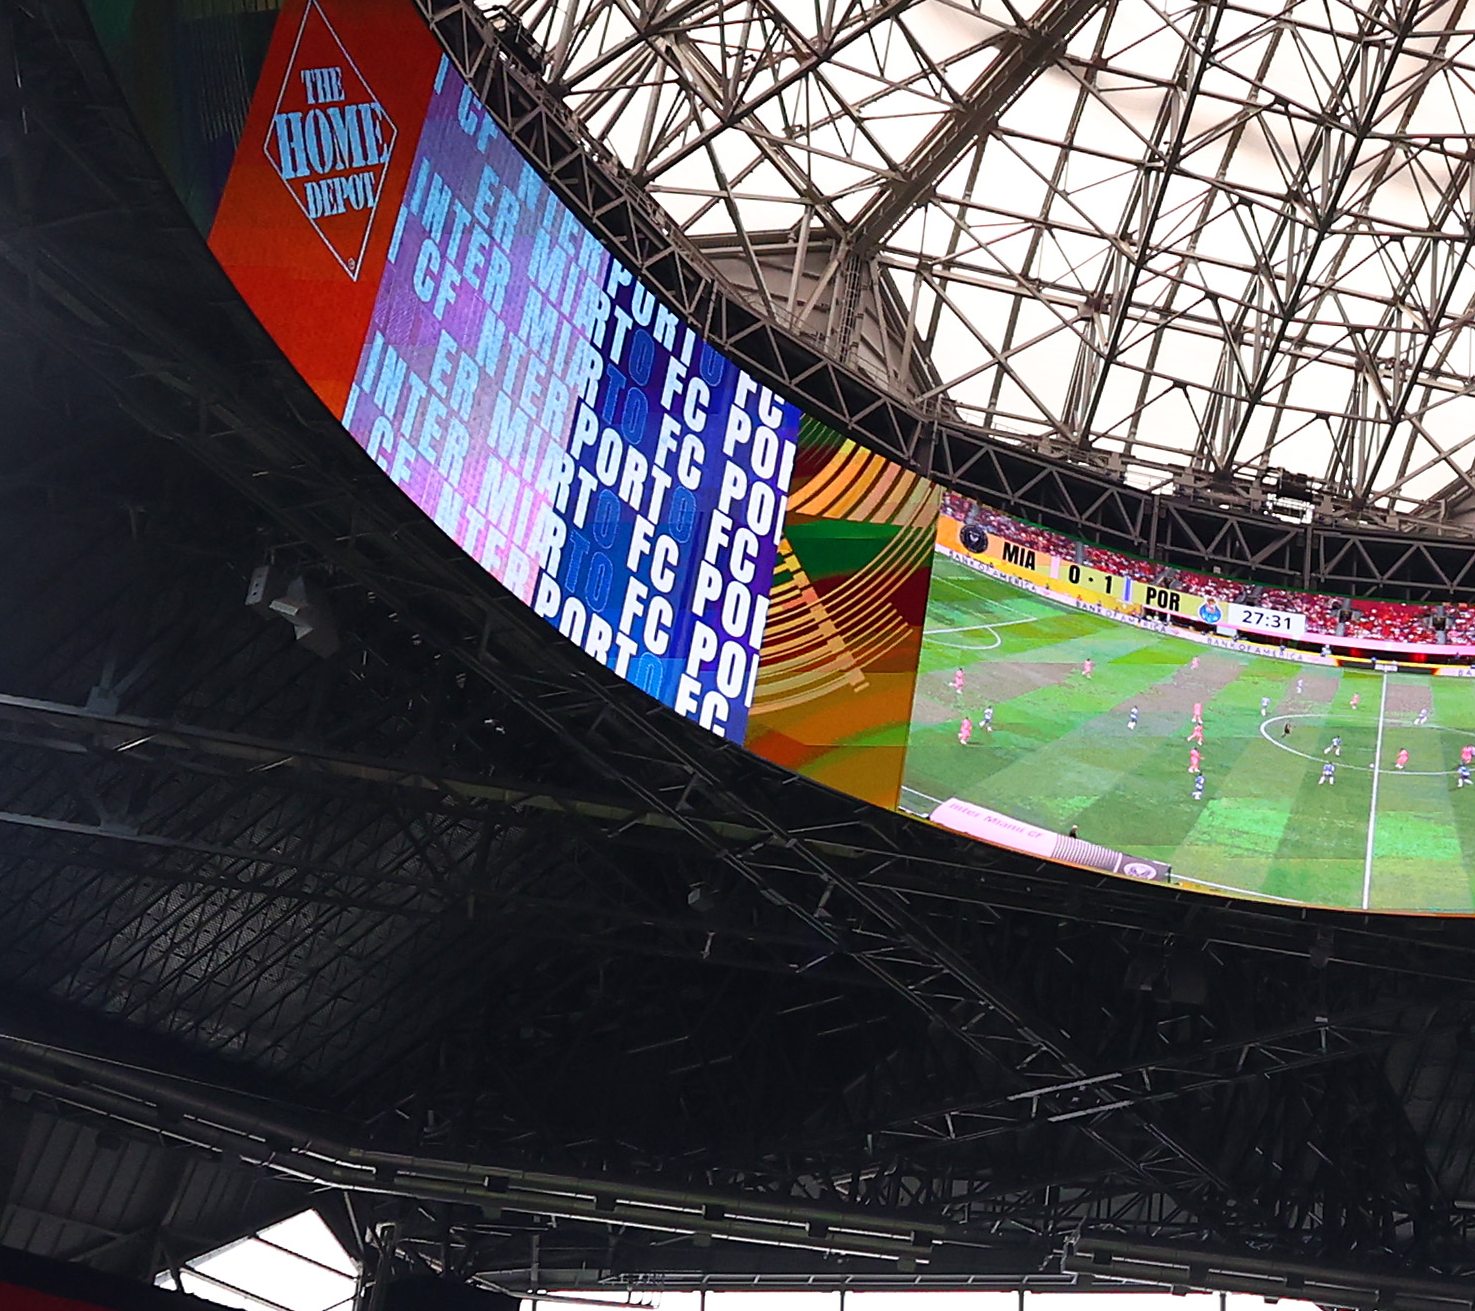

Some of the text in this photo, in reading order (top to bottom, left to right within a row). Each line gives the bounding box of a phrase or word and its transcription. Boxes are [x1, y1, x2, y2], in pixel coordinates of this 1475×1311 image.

[301, 67, 345, 104] THE
[274, 102, 391, 179] HOME
[304, 172, 375, 219] DEPOT
[410, 157, 512, 317] INTER
[655, 412, 706, 490] FC
[413, 239, 461, 320] CF
[704, 509, 759, 585] FC
[660, 355, 711, 432] FC
[363, 329, 469, 485] INTER
[619, 576, 673, 655] FC
[627, 514, 679, 593] FC
[949, 550, 975, 569] BANK
[992, 570, 1037, 592] AMERICA
[1002, 542, 1036, 571] MIA
[1069, 565, 1113, 594] 0 1
[1146, 586, 1180, 612] POR
[1242, 610, 1292, 630] 27:31
[1207, 637, 1304, 661] BANK OF AMERICA
